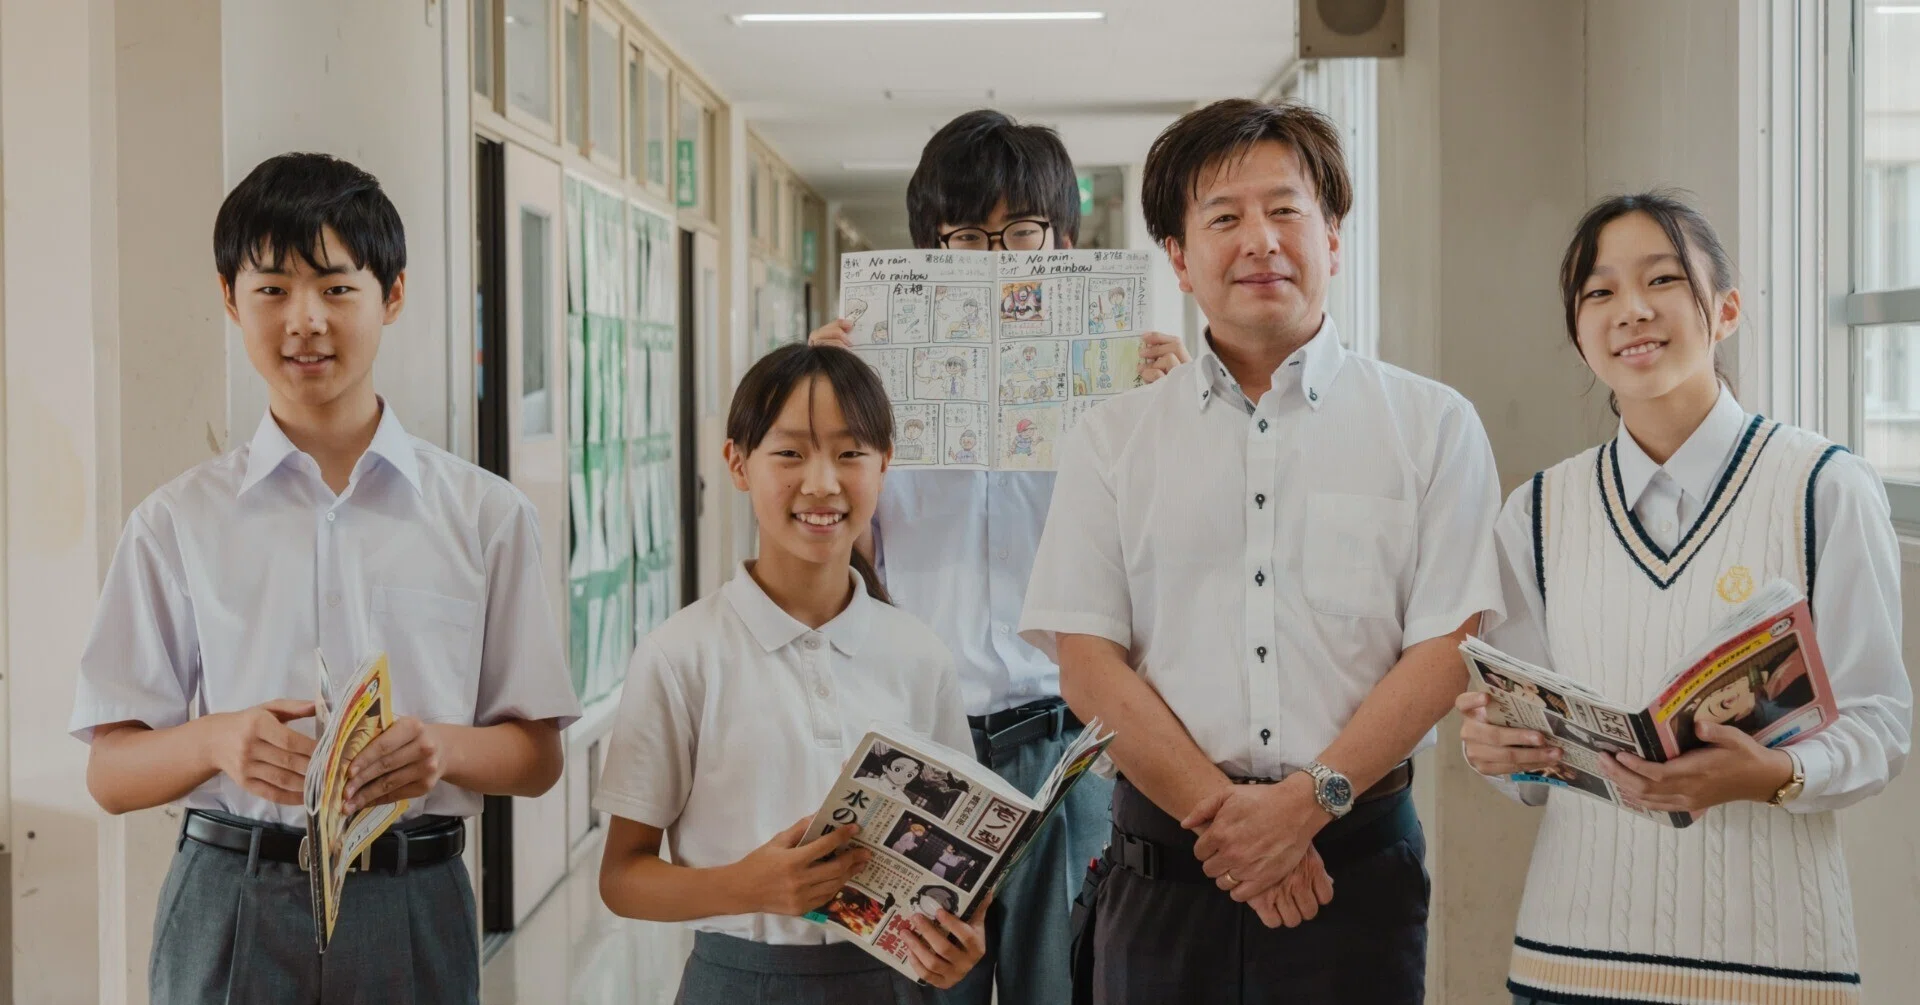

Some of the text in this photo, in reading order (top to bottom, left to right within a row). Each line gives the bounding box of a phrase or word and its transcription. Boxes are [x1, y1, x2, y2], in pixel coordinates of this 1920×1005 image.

[869, 257, 884, 267] No
[1026, 254, 1043, 264] No
[1031, 265, 1046, 275] No
[1050, 263, 1092, 274] rainbow
[870, 269, 928, 280] No rainbow
